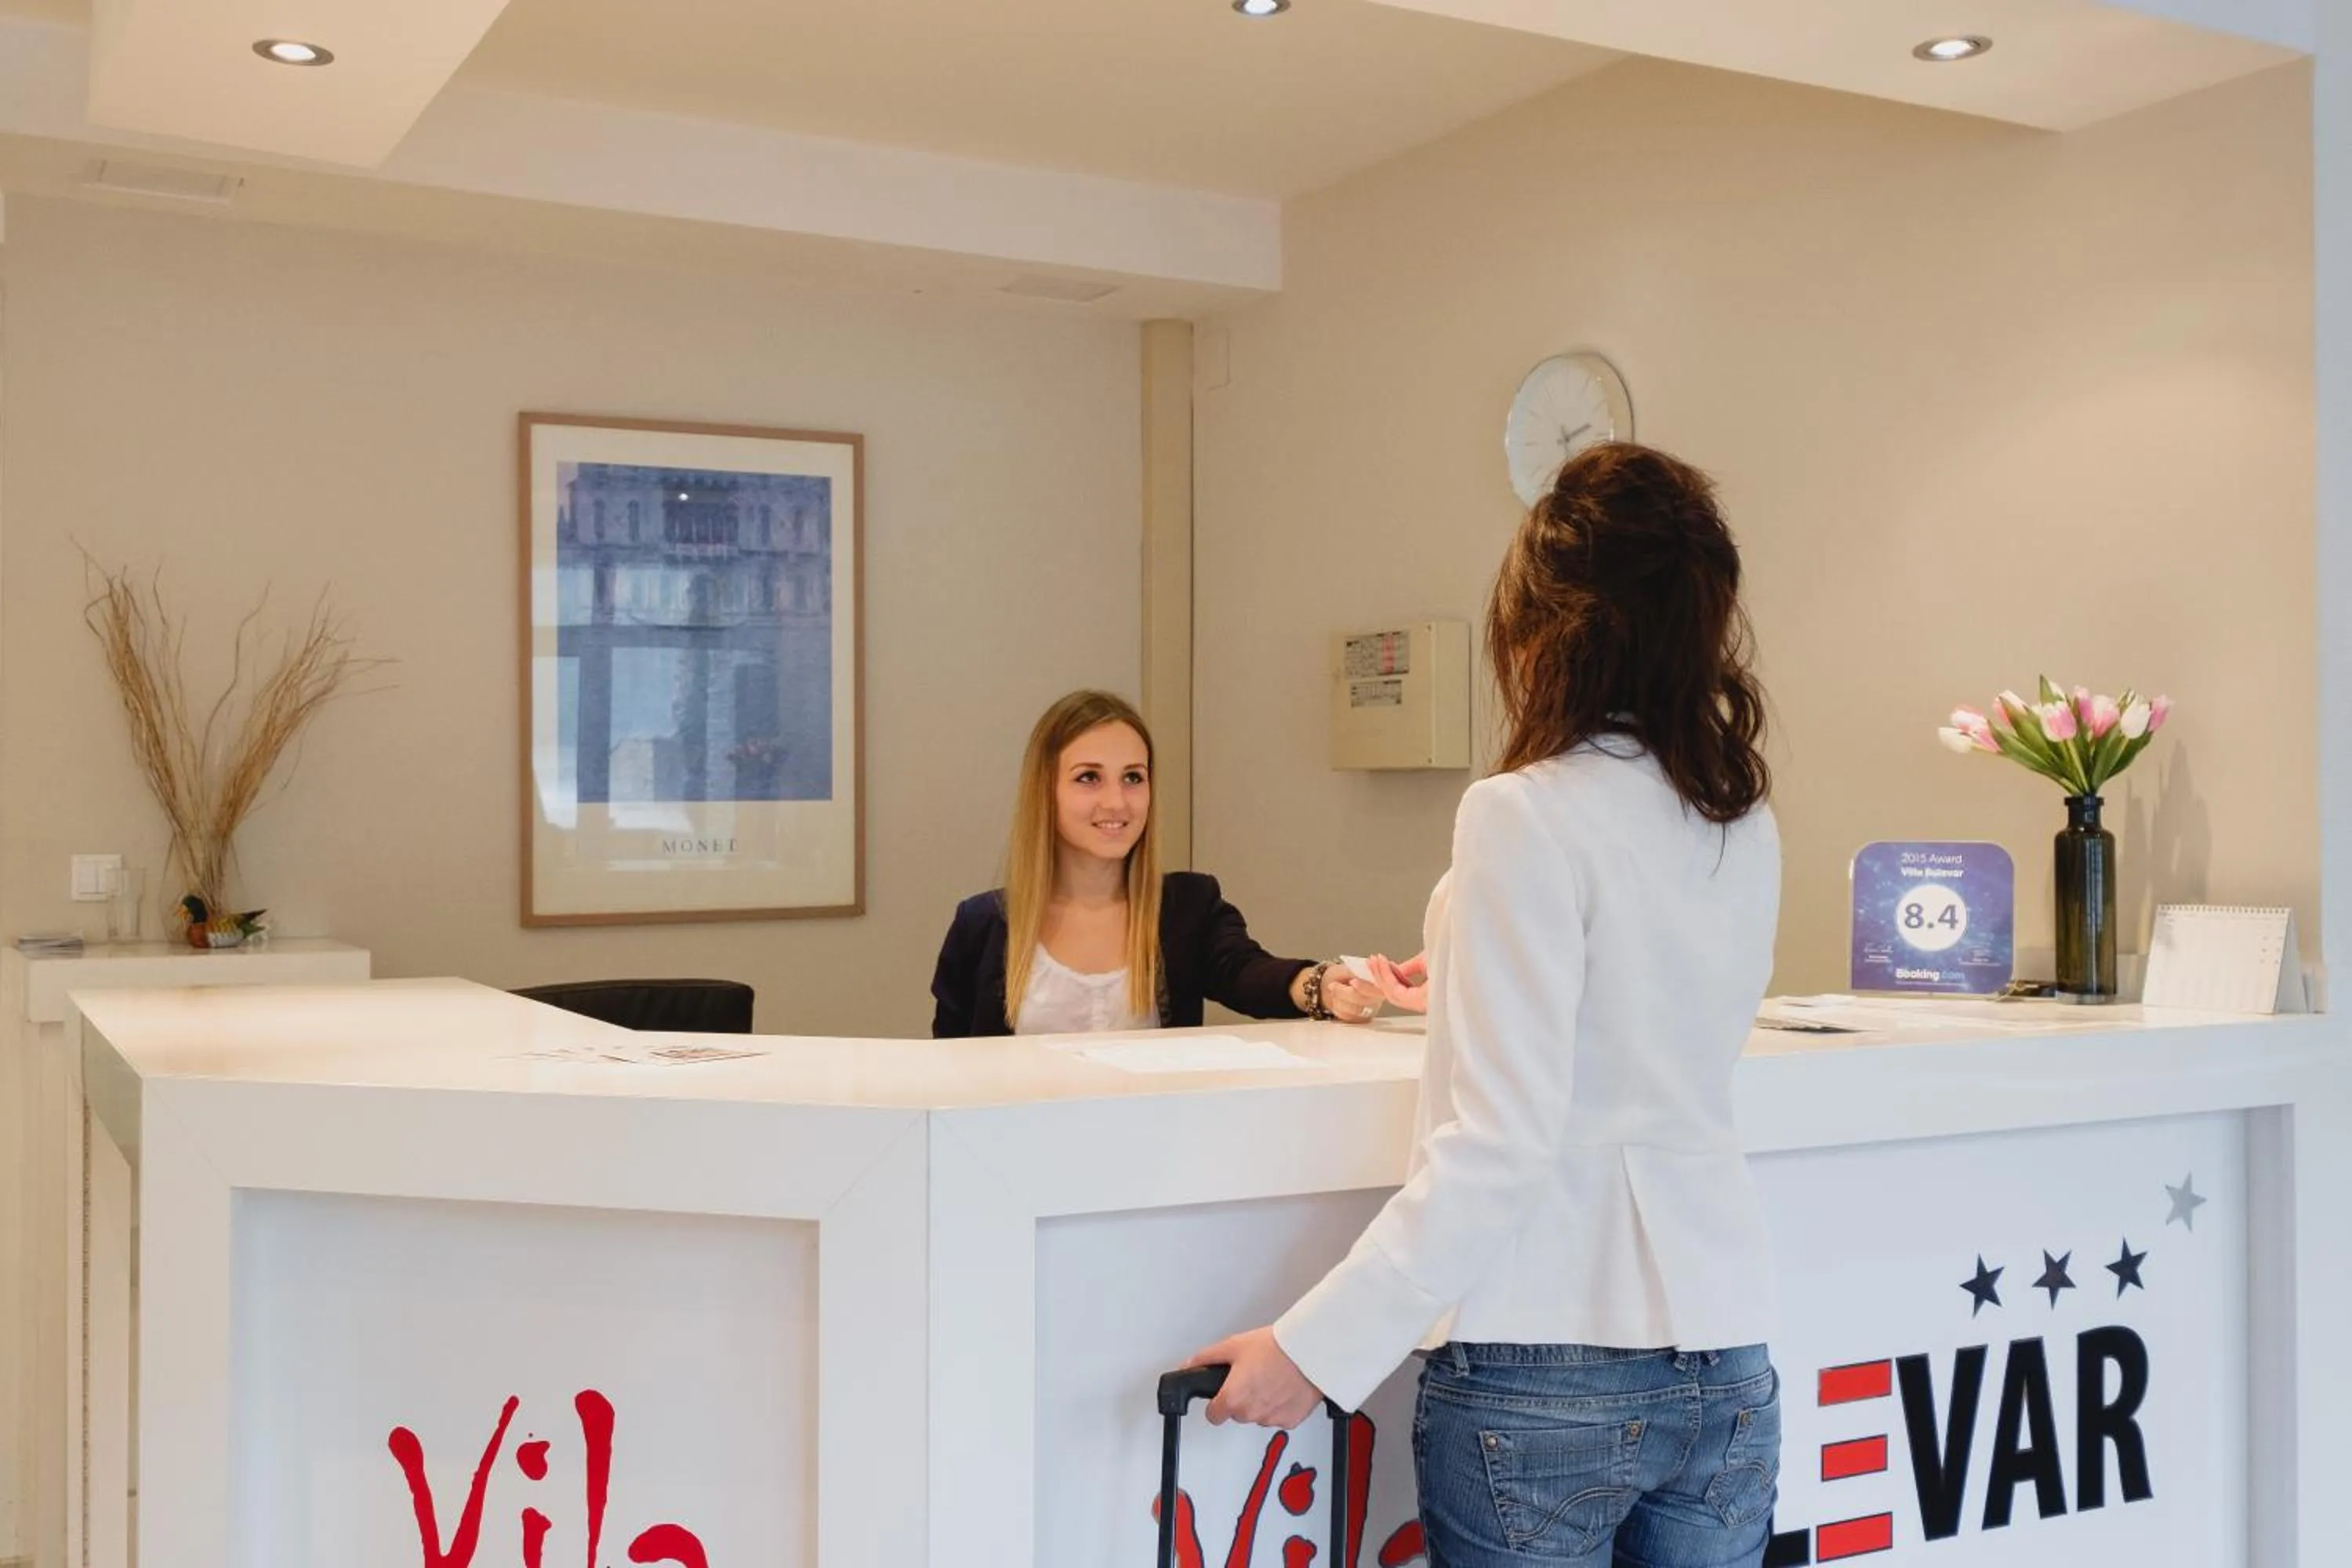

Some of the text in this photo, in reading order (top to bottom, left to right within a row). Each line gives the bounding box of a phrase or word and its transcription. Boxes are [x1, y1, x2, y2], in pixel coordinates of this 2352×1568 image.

[662, 838, 739, 854] MONET
[1930, 852, 1962, 863] Award
[1904, 902, 1958, 930] 8.4
